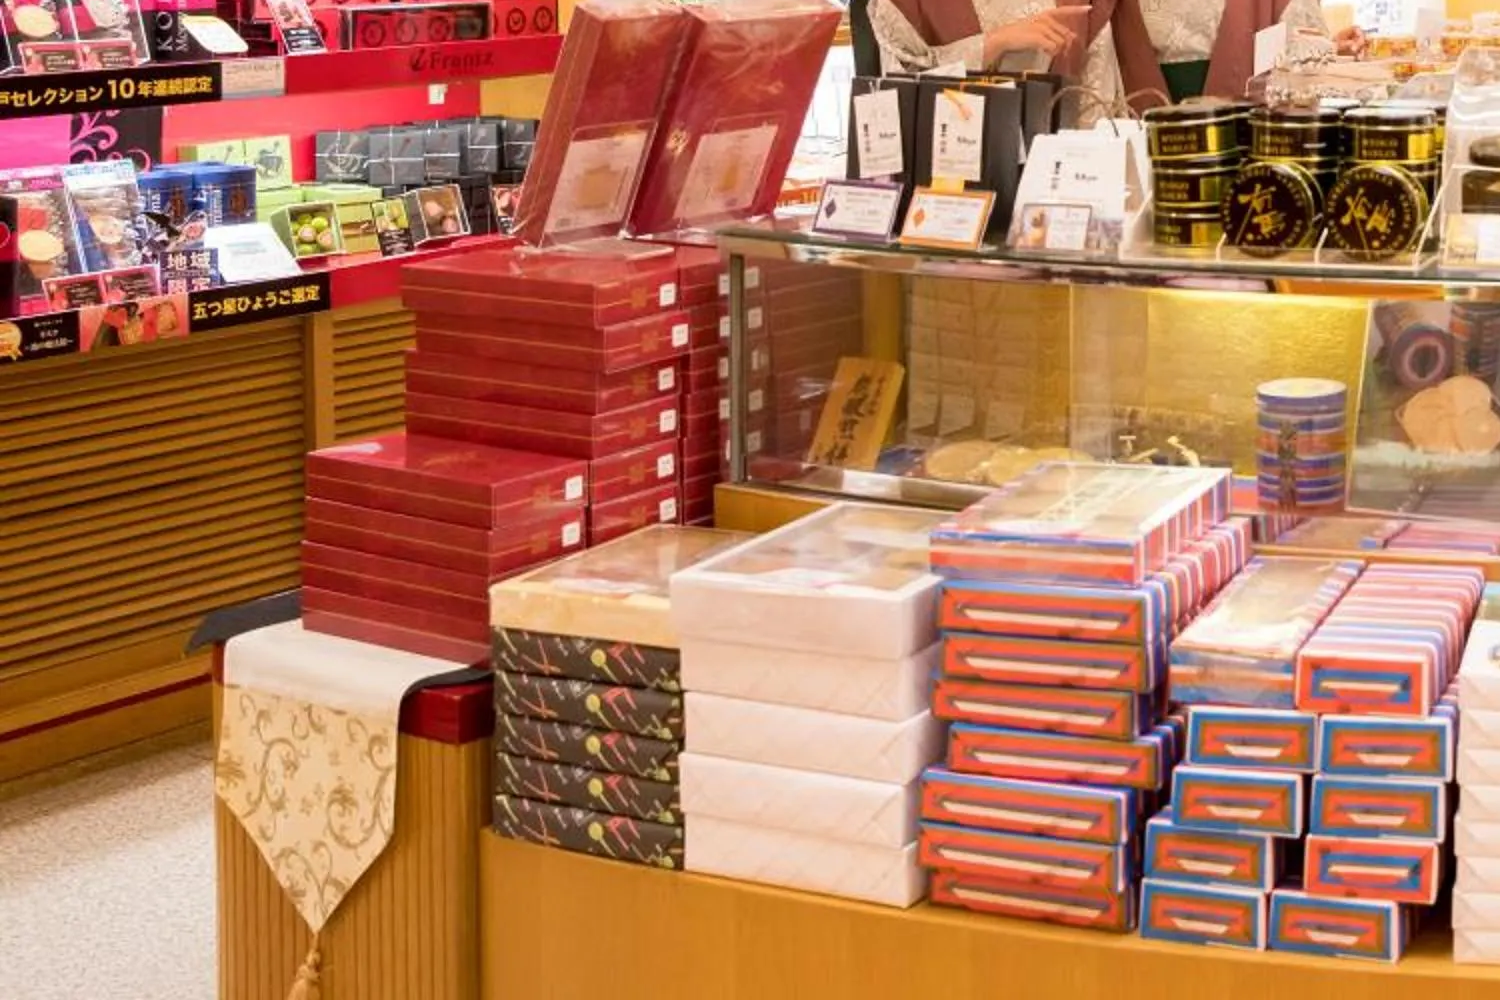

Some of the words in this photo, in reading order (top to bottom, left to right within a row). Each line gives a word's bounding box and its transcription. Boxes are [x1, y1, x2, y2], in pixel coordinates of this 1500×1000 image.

[429, 51, 495, 71] Frantz
[193, 284, 320, 320] 五つ星ひょうご選定
